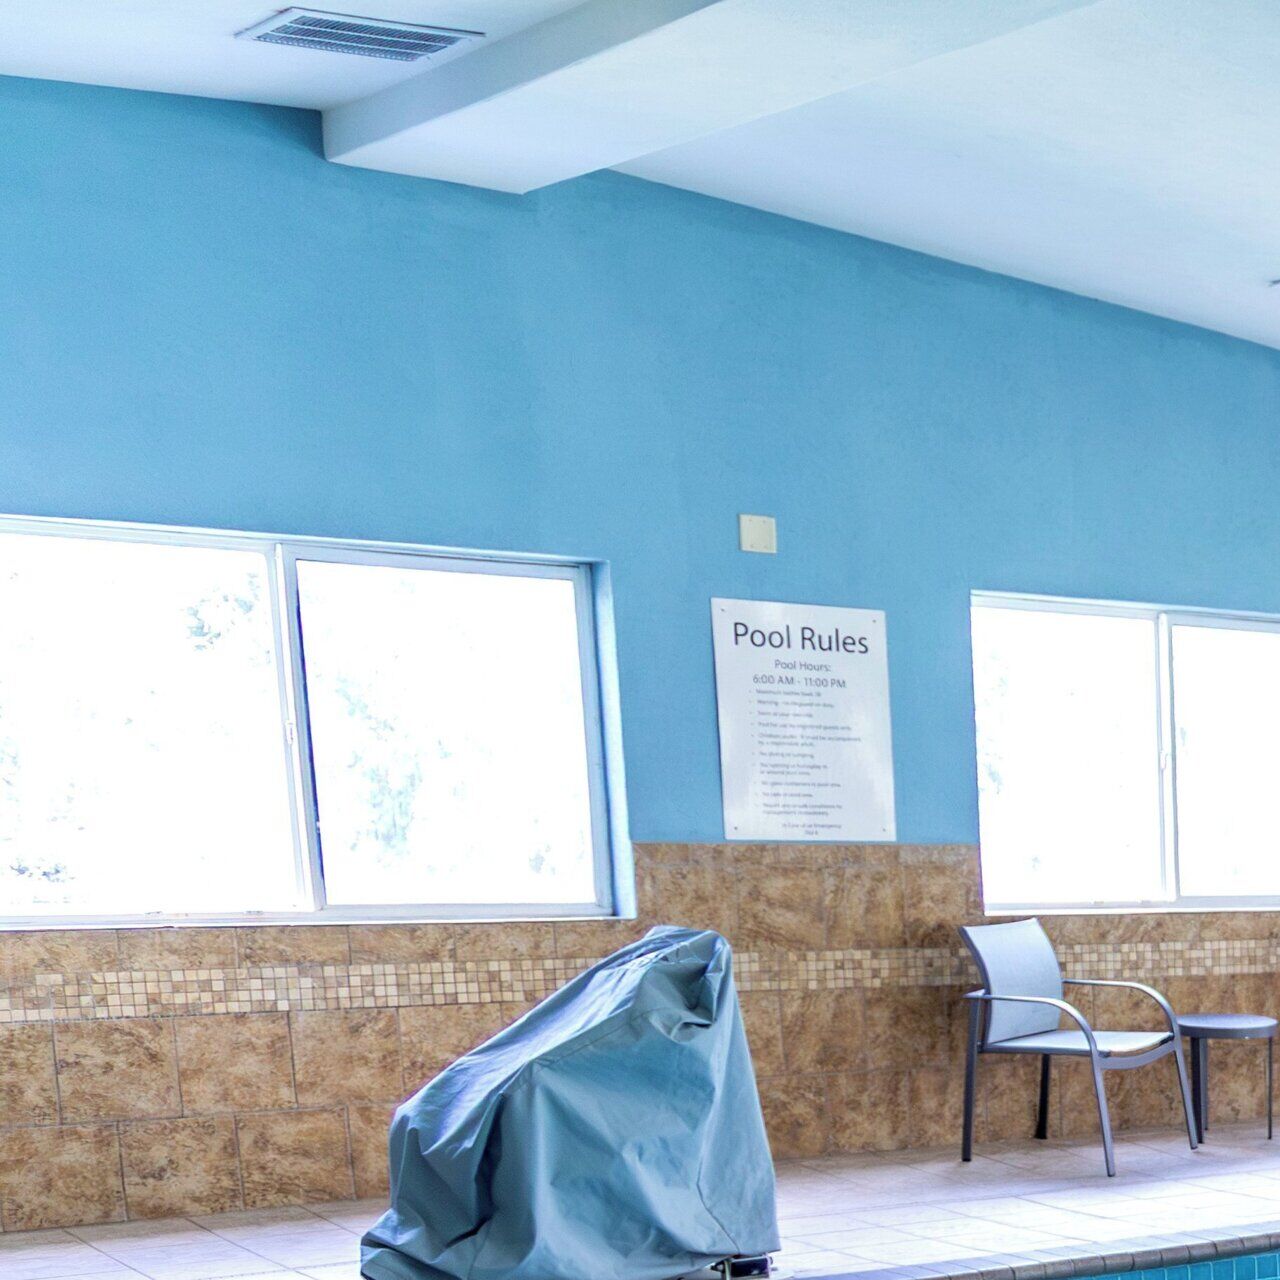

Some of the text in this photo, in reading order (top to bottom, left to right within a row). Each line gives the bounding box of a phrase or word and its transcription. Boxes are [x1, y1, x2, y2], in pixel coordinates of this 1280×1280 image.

[733, 621, 869, 654] Pool Rules
[774, 659, 832, 672] Pool Hours:
[753, 674, 774, 684] 6:00
[777, 676, 794, 685] AM
[804, 677, 828, 688] 11:00
[830, 678, 846, 688] PM
